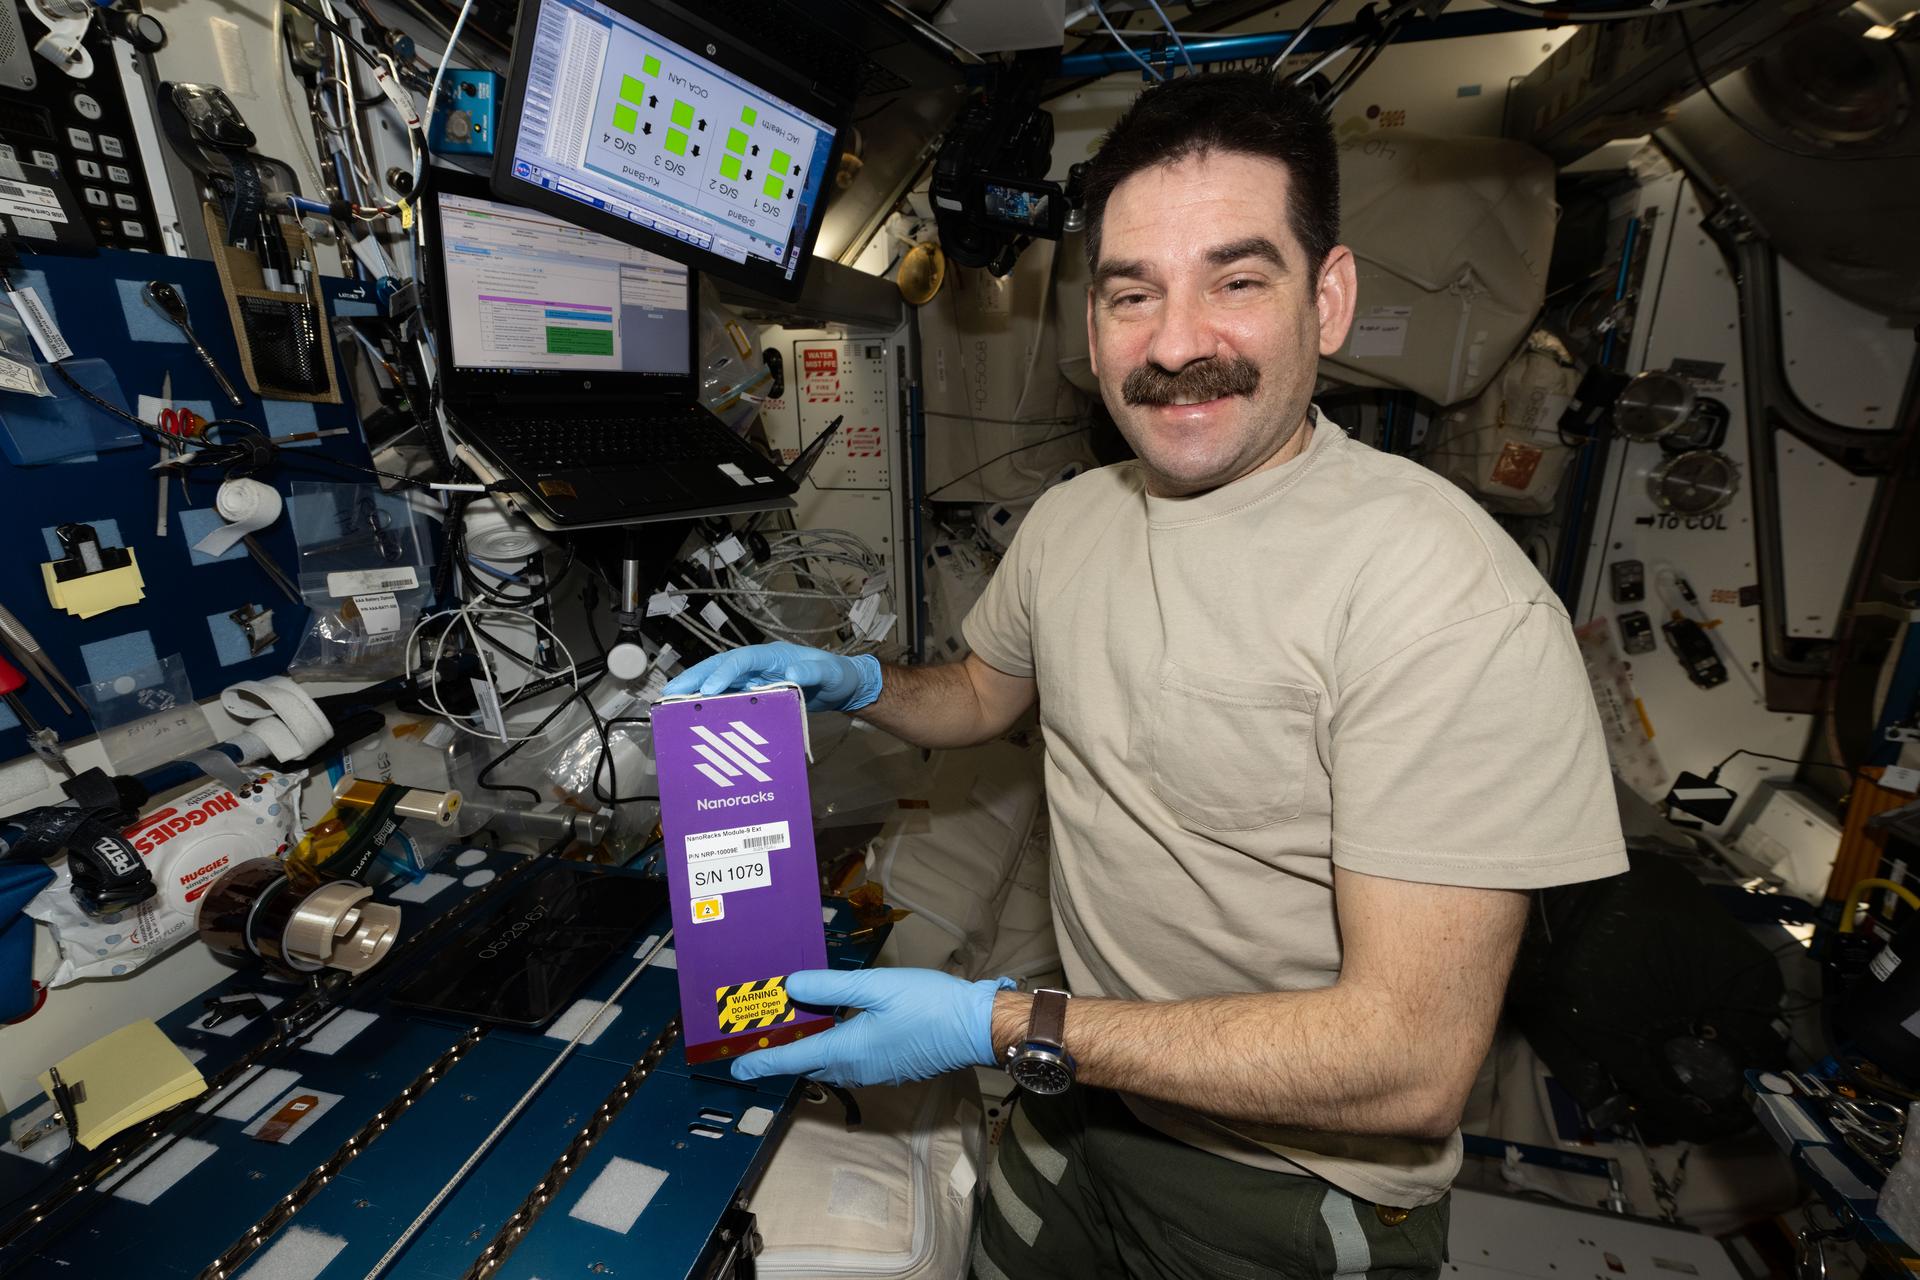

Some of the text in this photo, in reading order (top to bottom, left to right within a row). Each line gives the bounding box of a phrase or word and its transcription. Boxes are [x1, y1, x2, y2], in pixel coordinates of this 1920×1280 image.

[667, 71, 709, 99] OCA LAN
[79, 101, 97, 112] PTT
[761, 119, 786, 137] Health
[602, 132, 637, 155] S/G 4
[654, 154, 686, 176] S/G 3
[622, 164, 660, 187] Ku-Band
[708, 178, 739, 200] S/G 2
[13, 205, 35, 214] Reader
[34, 207, 50, 216] Card
[762, 201, 781, 218] S/G
[808, 351, 833, 359] WATER
[805, 360, 837, 368] MIST PFE
[1657, 513, 1728, 531] To COL
[696, 791, 775, 811] Nanoracks
[134, 791, 240, 856] HUGGIES
[686, 832, 722, 842] NanoRacks
[723, 828, 751, 837] Module-9
[96, 837, 140, 876] PETZL
[180, 855, 230, 886] HUGGIES
[695, 863, 764, 886] S/N 1079
[186, 874, 211, 891] simply
[163, 920, 186, 937] FLUSH
[731, 988, 778, 1004] WARNING
[731, 1000, 781, 1015] DO NOT Open
[735, 1008, 779, 1021] Sealed Bags
